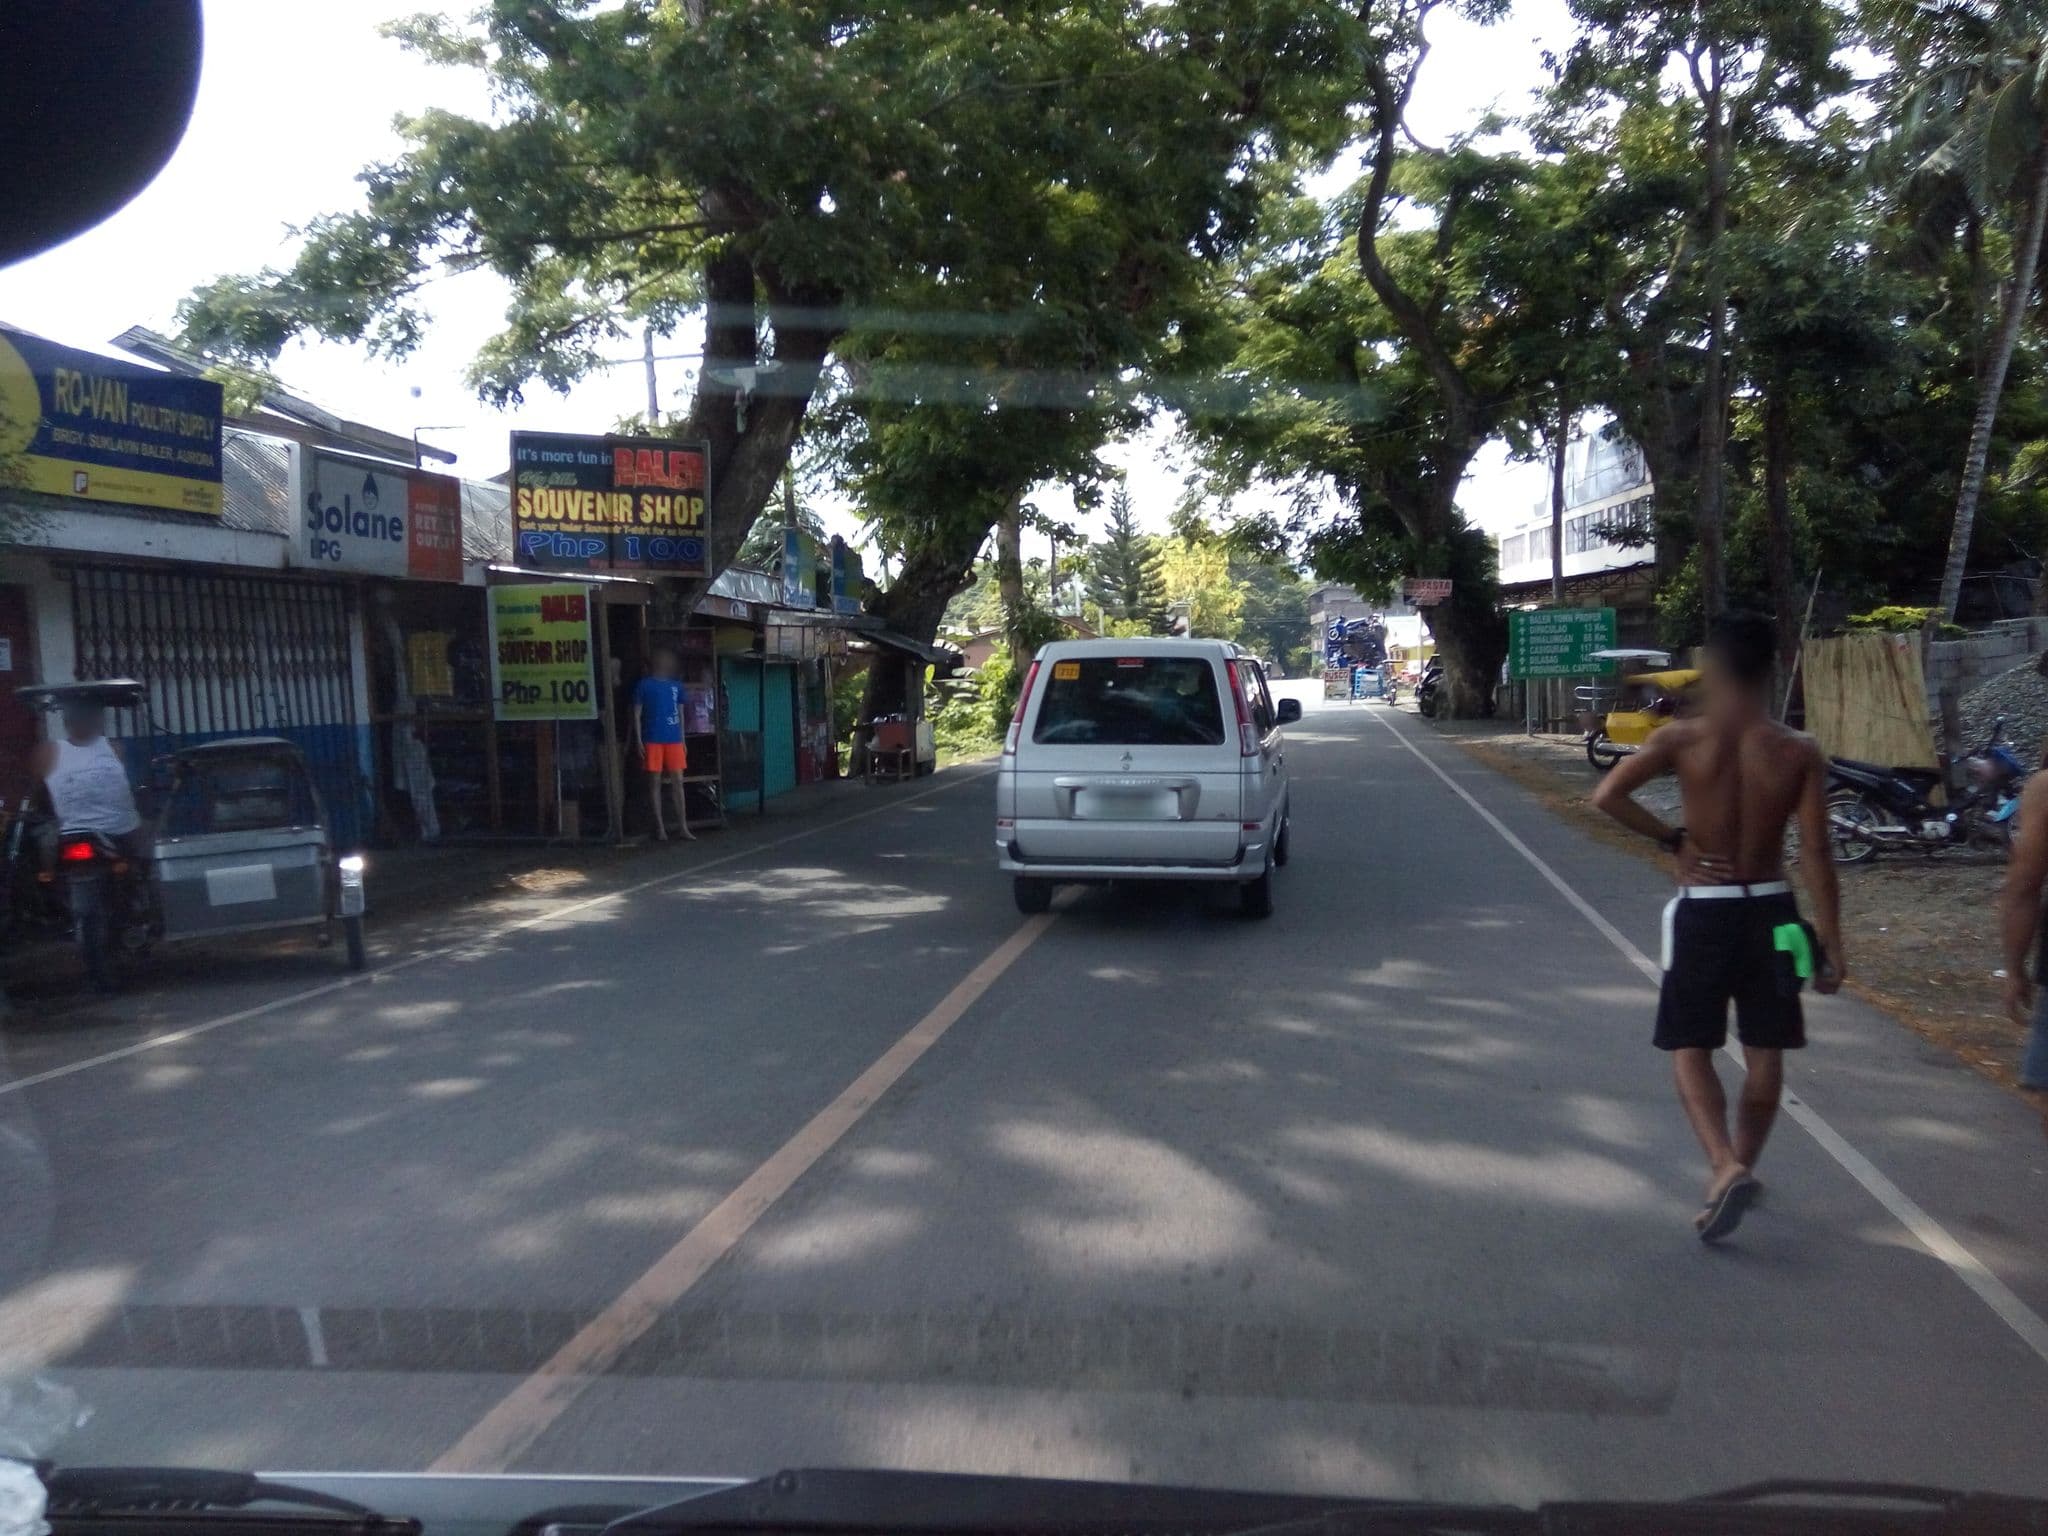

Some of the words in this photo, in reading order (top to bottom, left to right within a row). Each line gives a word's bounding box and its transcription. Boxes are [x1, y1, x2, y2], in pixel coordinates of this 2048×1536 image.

[54, 367, 128, 424] RO-VAN
[131, 402, 176, 433] POULTRY
[180, 410, 215, 440] SUPPLY
[517, 448, 538, 461] It's
[541, 451, 574, 463] more
[577, 450, 598, 465] fun
[601, 452, 613, 464] in
[614, 447, 705, 489] BALER
[307, 490, 404, 542] Solane
[517, 487, 634, 523] SOUVENIR
[639, 493, 705, 526] SHOP
[519, 531, 605, 558] Php
[625, 536, 705, 561] 100
[498, 640, 553, 664] SOUVENIR
[555, 639, 588, 664] SHOP
[1572, 663, 1602, 673] CAPITOL
[502, 680, 541, 704] Php
[550, 680, 589, 704] 100
